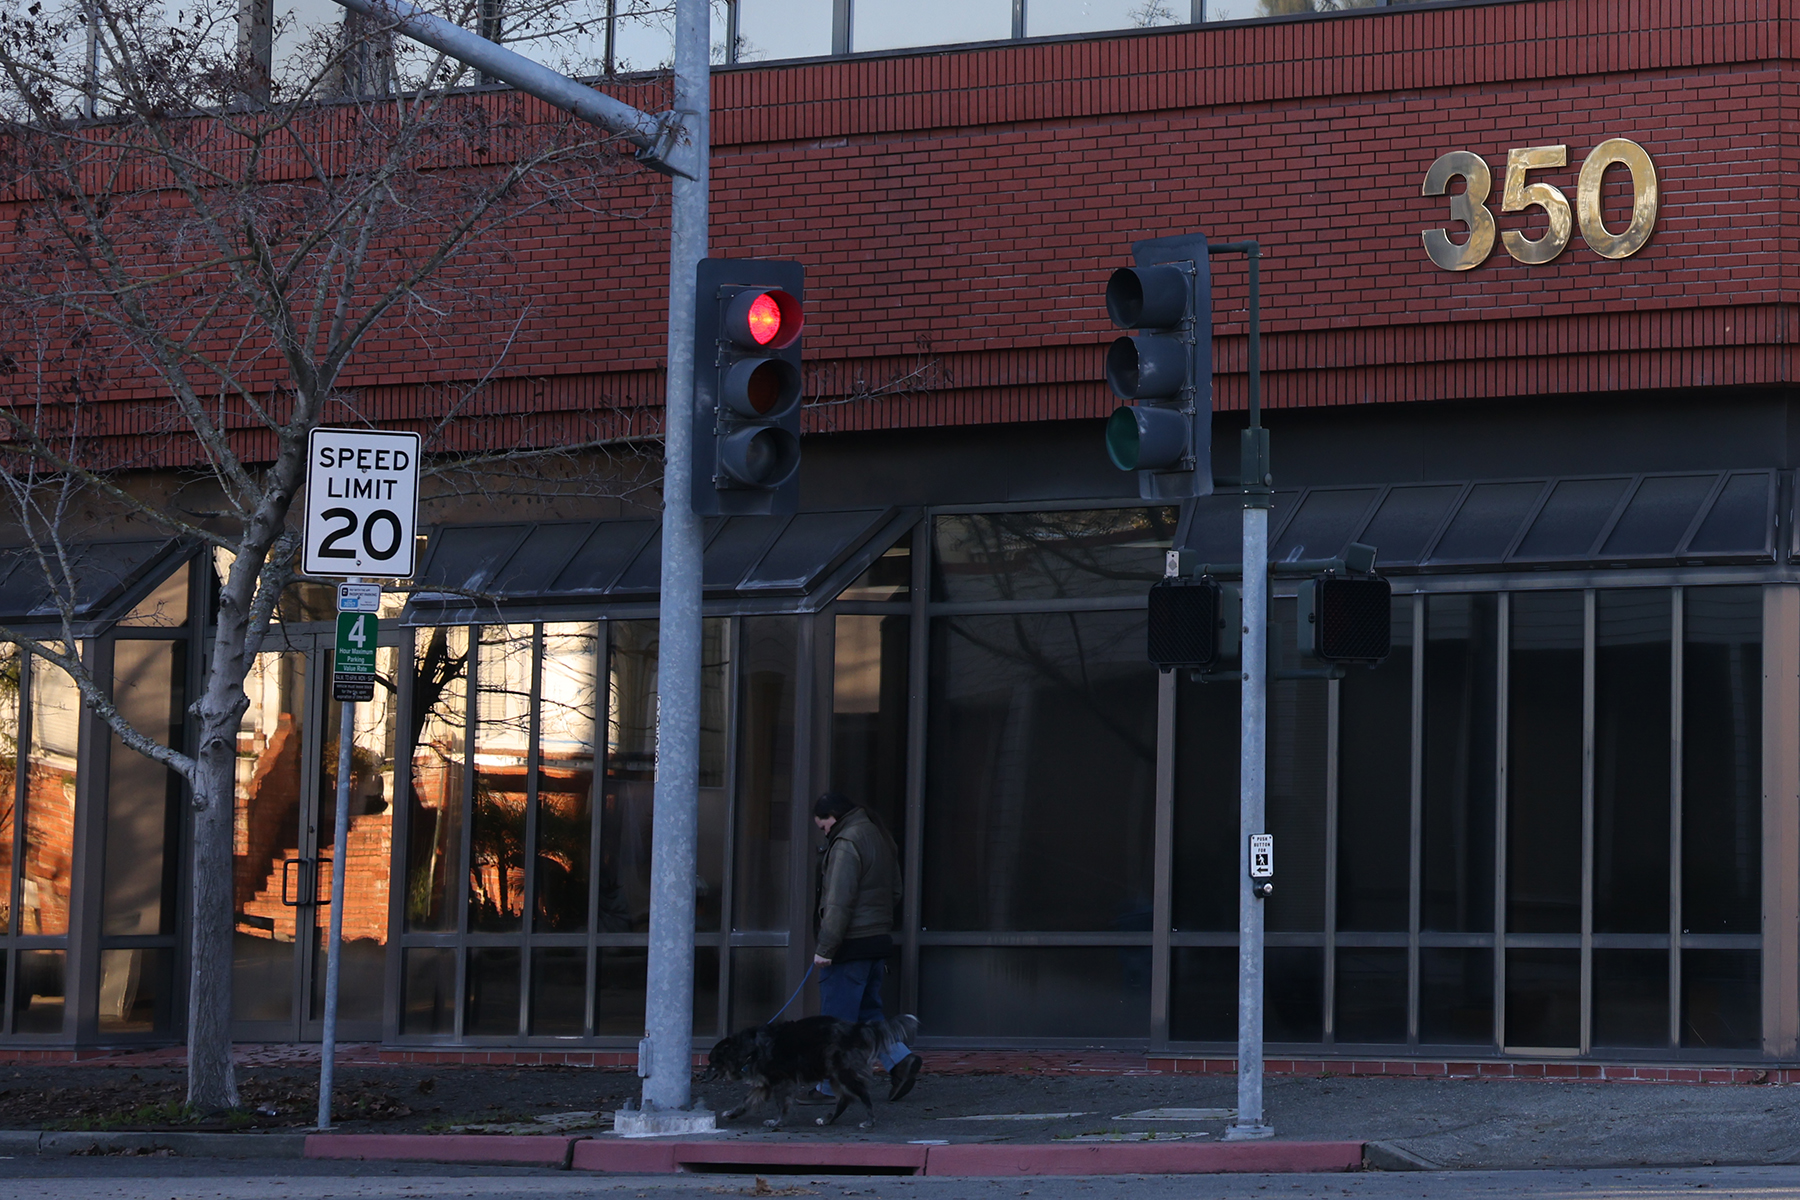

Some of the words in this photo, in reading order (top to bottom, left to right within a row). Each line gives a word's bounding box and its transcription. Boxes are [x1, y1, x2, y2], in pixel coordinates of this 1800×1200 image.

[1421, 136, 1659, 272] 350
[319, 446, 410, 471] SPEED
[327, 477, 398, 500] LIMIT
[318, 507, 403, 561] 20
[348, 614, 367, 648] 4
[346, 655, 365, 664] Parking
